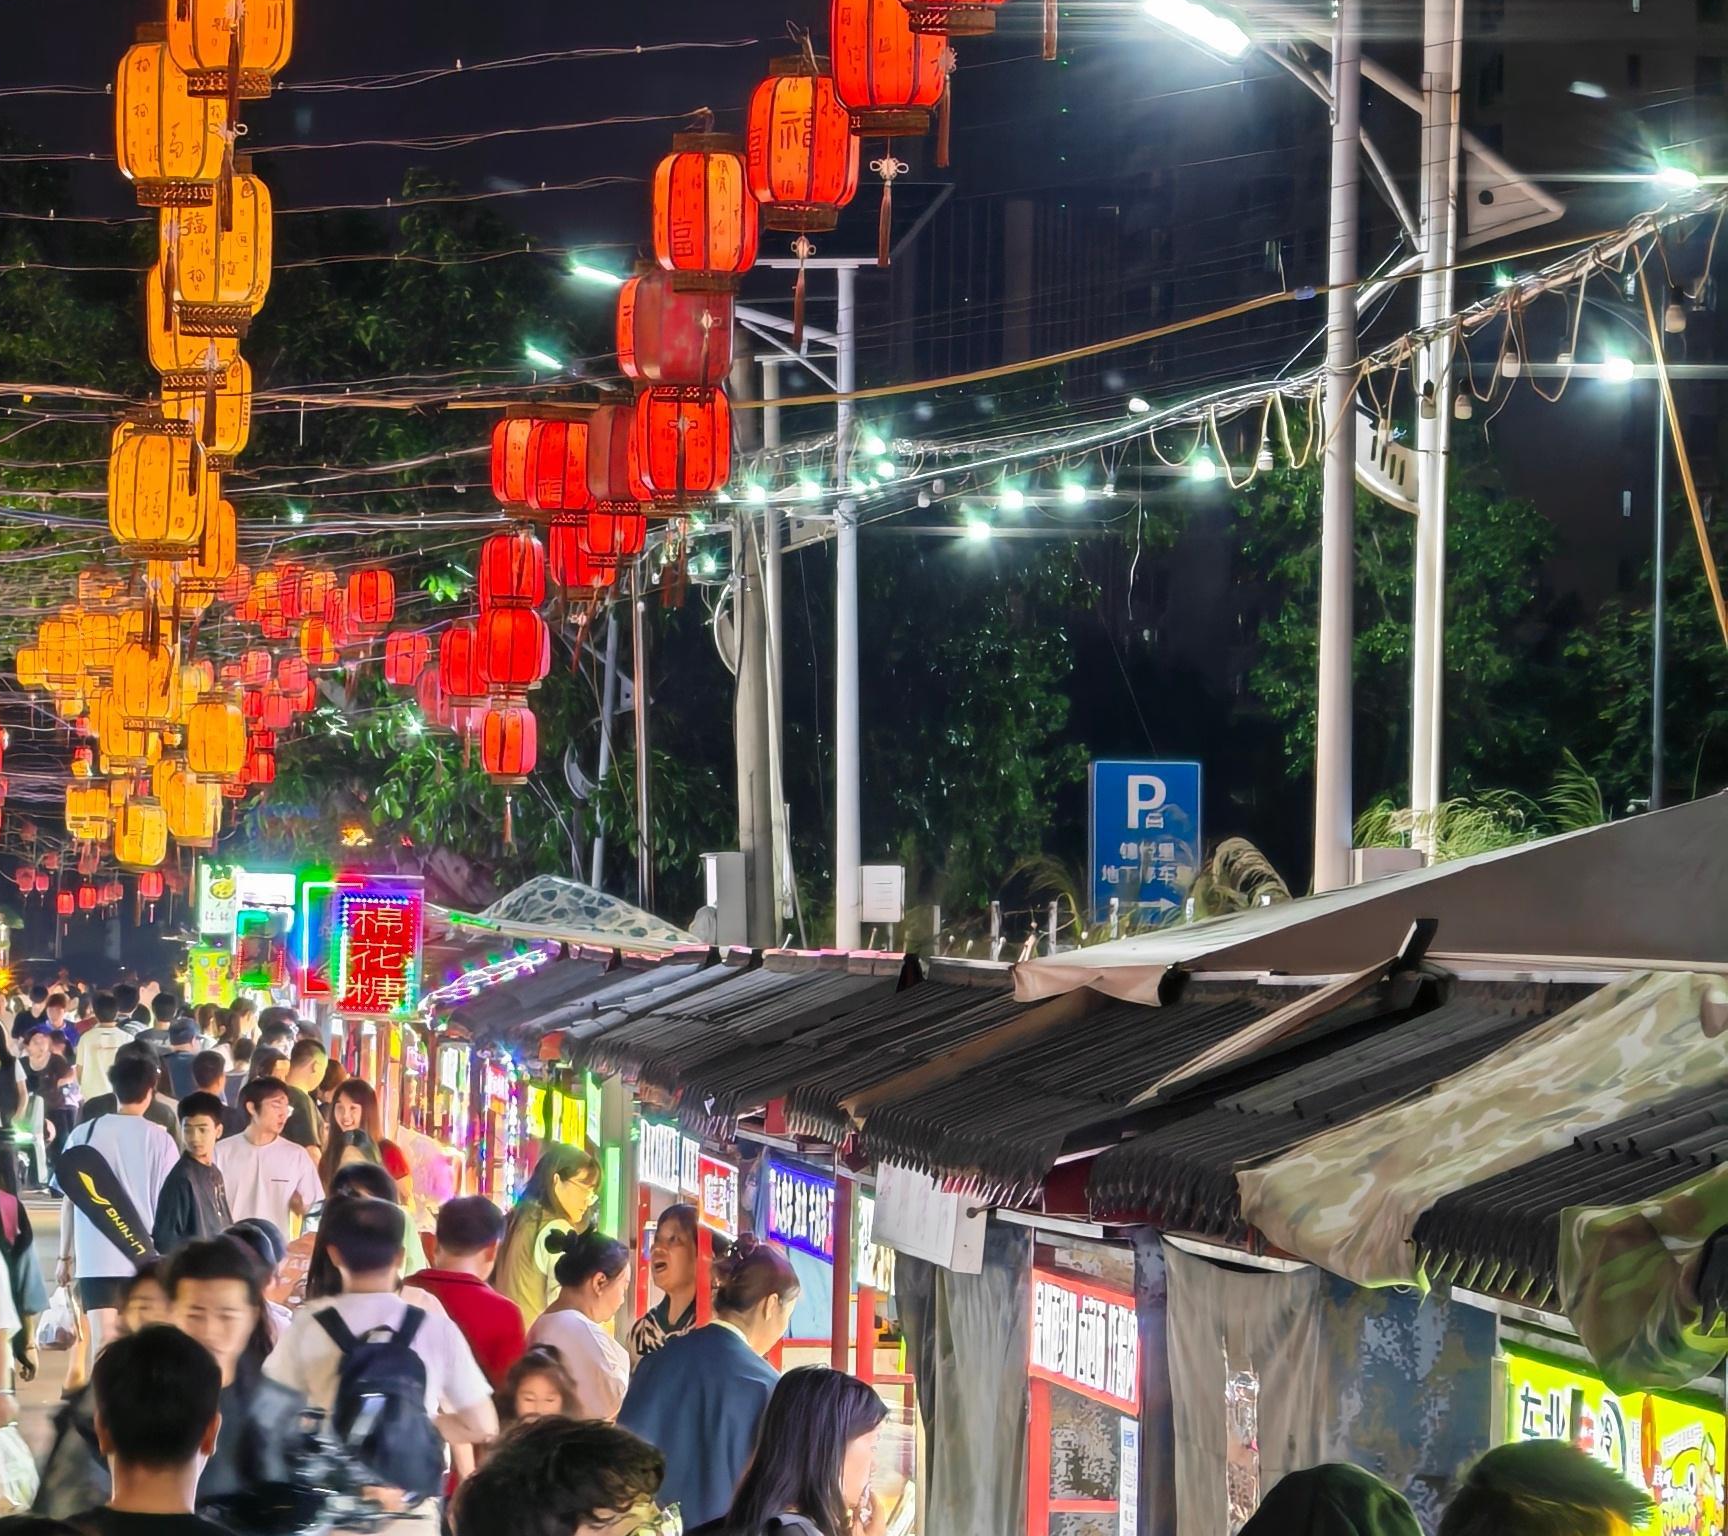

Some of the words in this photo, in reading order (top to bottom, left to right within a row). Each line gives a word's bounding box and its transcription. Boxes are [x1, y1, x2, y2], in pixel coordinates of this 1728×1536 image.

[1127, 775, 1167, 829] P
[346, 904, 408, 1006] 棉花糖
